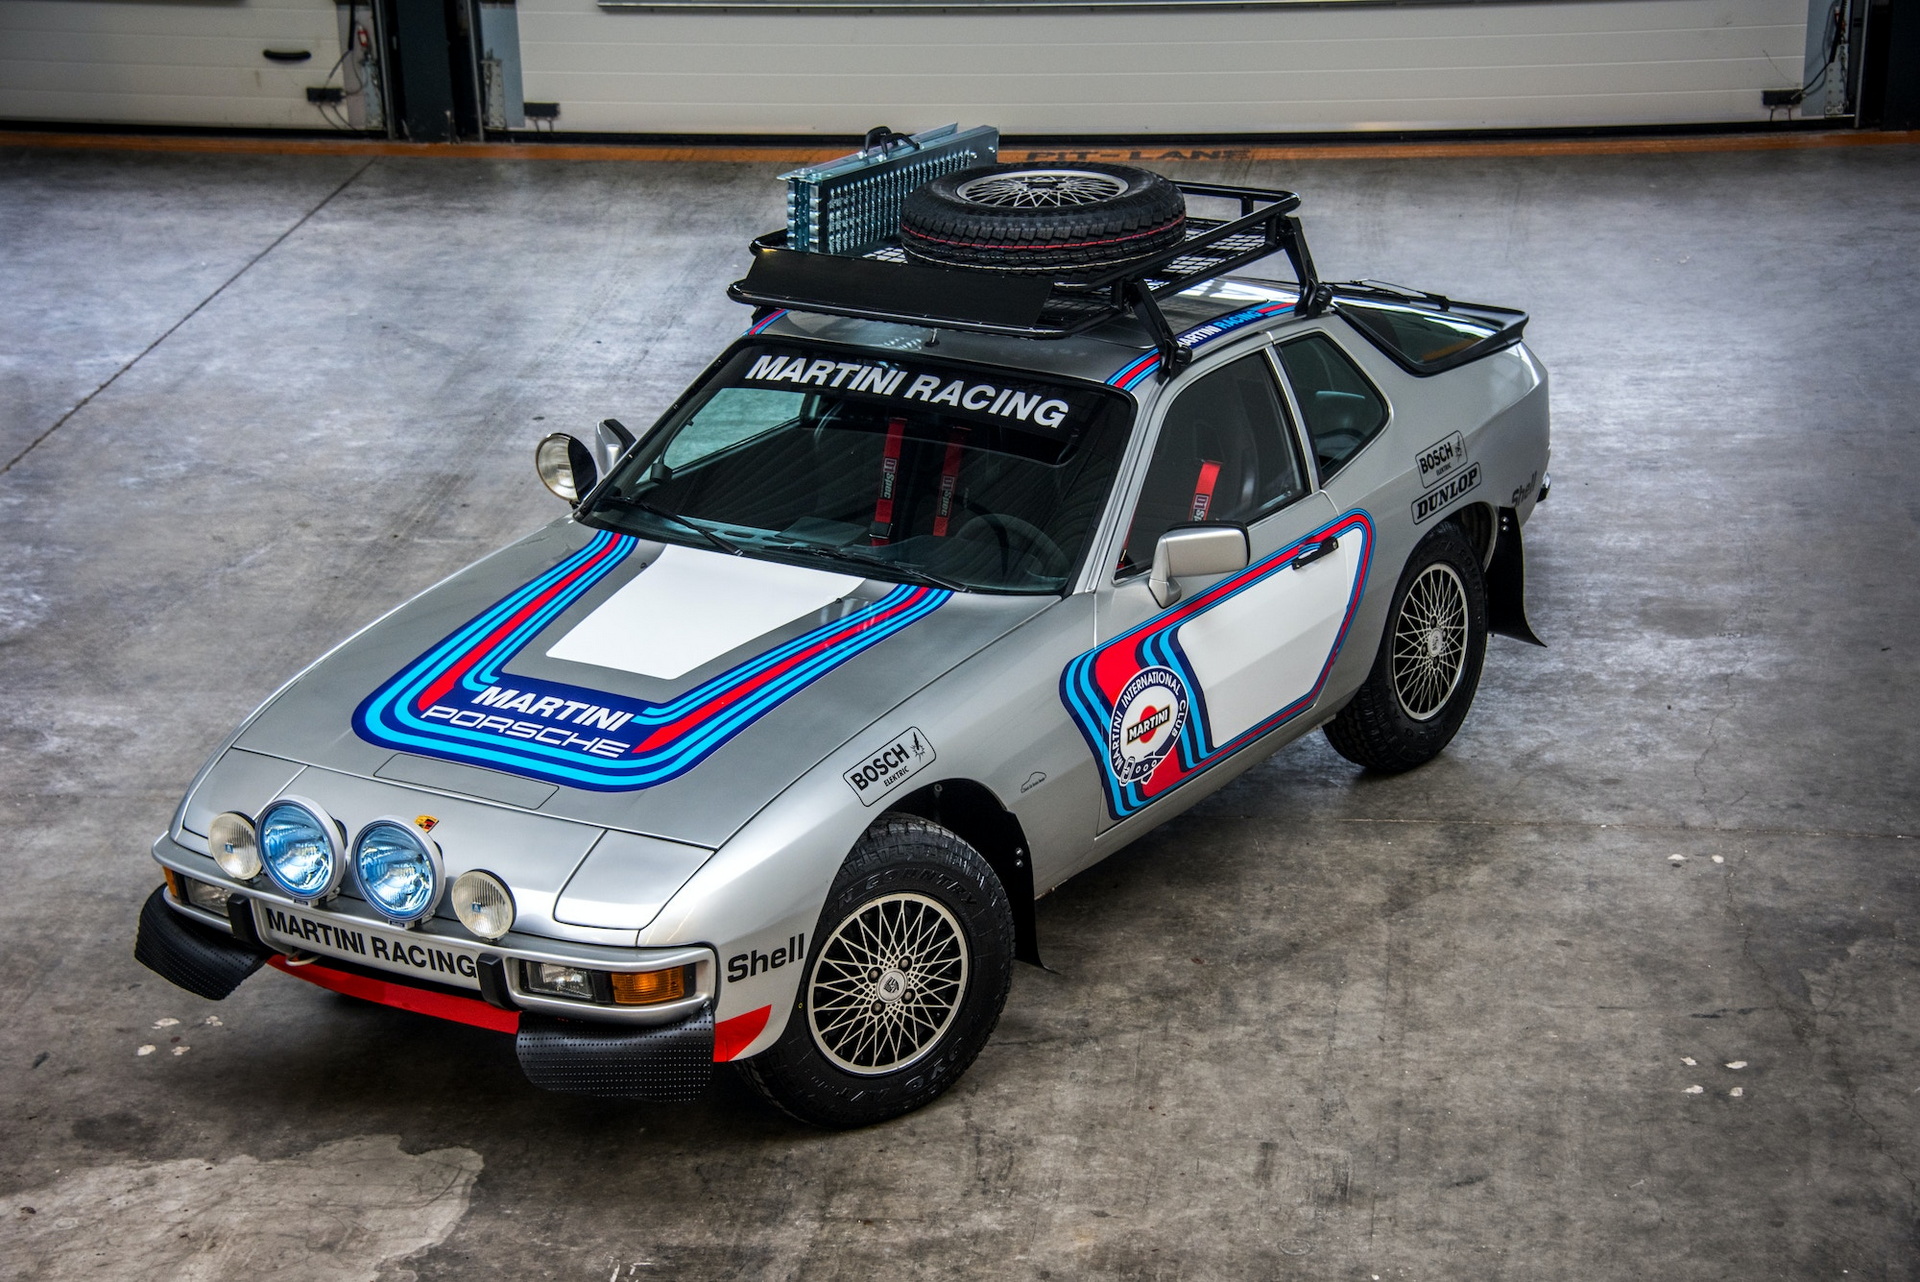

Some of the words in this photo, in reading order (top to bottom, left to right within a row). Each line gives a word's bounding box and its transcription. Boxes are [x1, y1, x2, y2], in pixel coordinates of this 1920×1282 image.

[1213, 309, 1264, 329] RACING
[745, 355, 908, 396] MARTINI
[904, 374, 1069, 429] RACING
[1419, 442, 1454, 474] BOSCH
[1417, 468, 1477, 519] DUNLOP
[1511, 470, 1538, 507] Shell
[420, 705, 631, 758] PORSCHE
[471, 686, 635, 732] MARTINI
[1112, 711, 1124, 770] MARTINI
[1121, 671, 1181, 709] INTERNATIONAL
[1171, 700, 1186, 738] CLUB
[1129, 709, 1168, 741] MARTINI
[850, 743, 910, 791] BOSCH
[883, 766, 910, 788] ELEKTRIC
[265, 907, 366, 955] MARTINI
[371, 935, 477, 979] RACING
[727, 933, 805, 983] Shell
